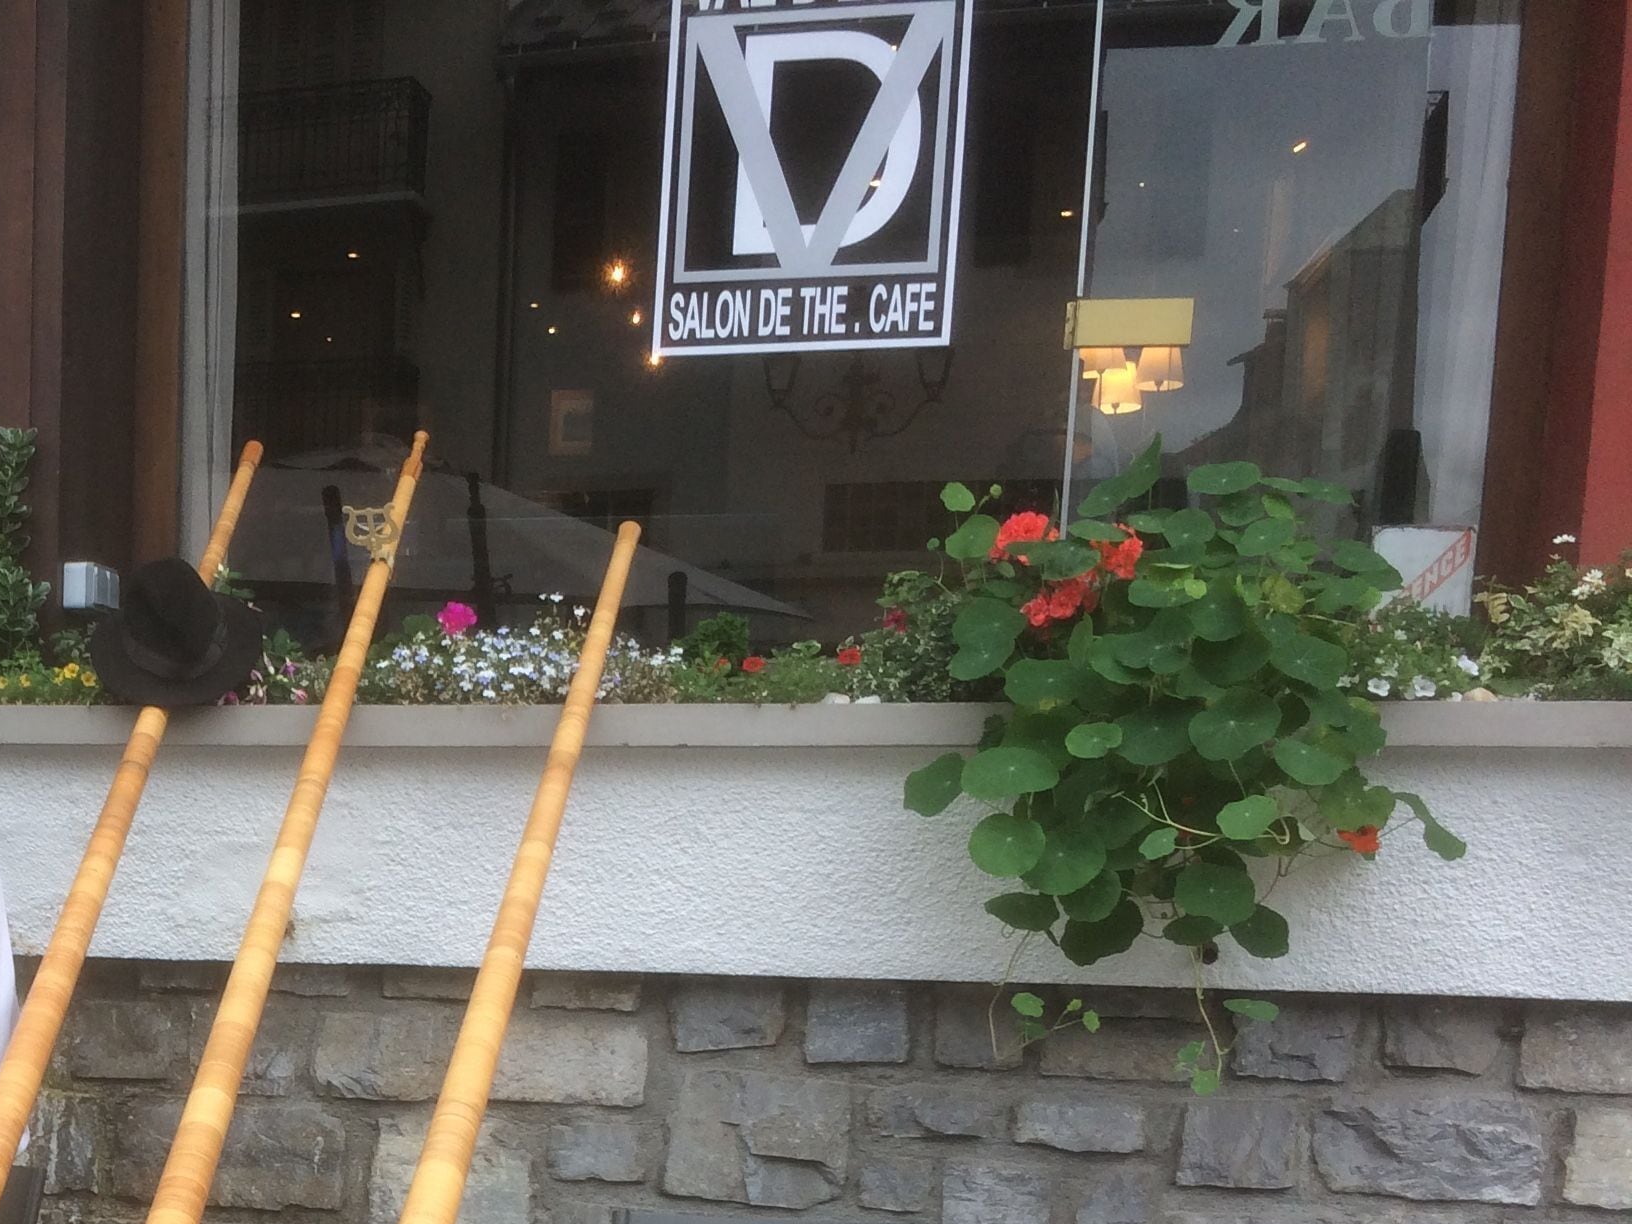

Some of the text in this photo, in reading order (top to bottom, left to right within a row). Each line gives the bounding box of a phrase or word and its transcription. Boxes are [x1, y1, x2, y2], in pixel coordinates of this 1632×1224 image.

[668, 289, 751, 340] SALON
[758, 288, 792, 337] DE
[800, 286, 848, 335] THE
[869, 283, 937, 333] CAFE
